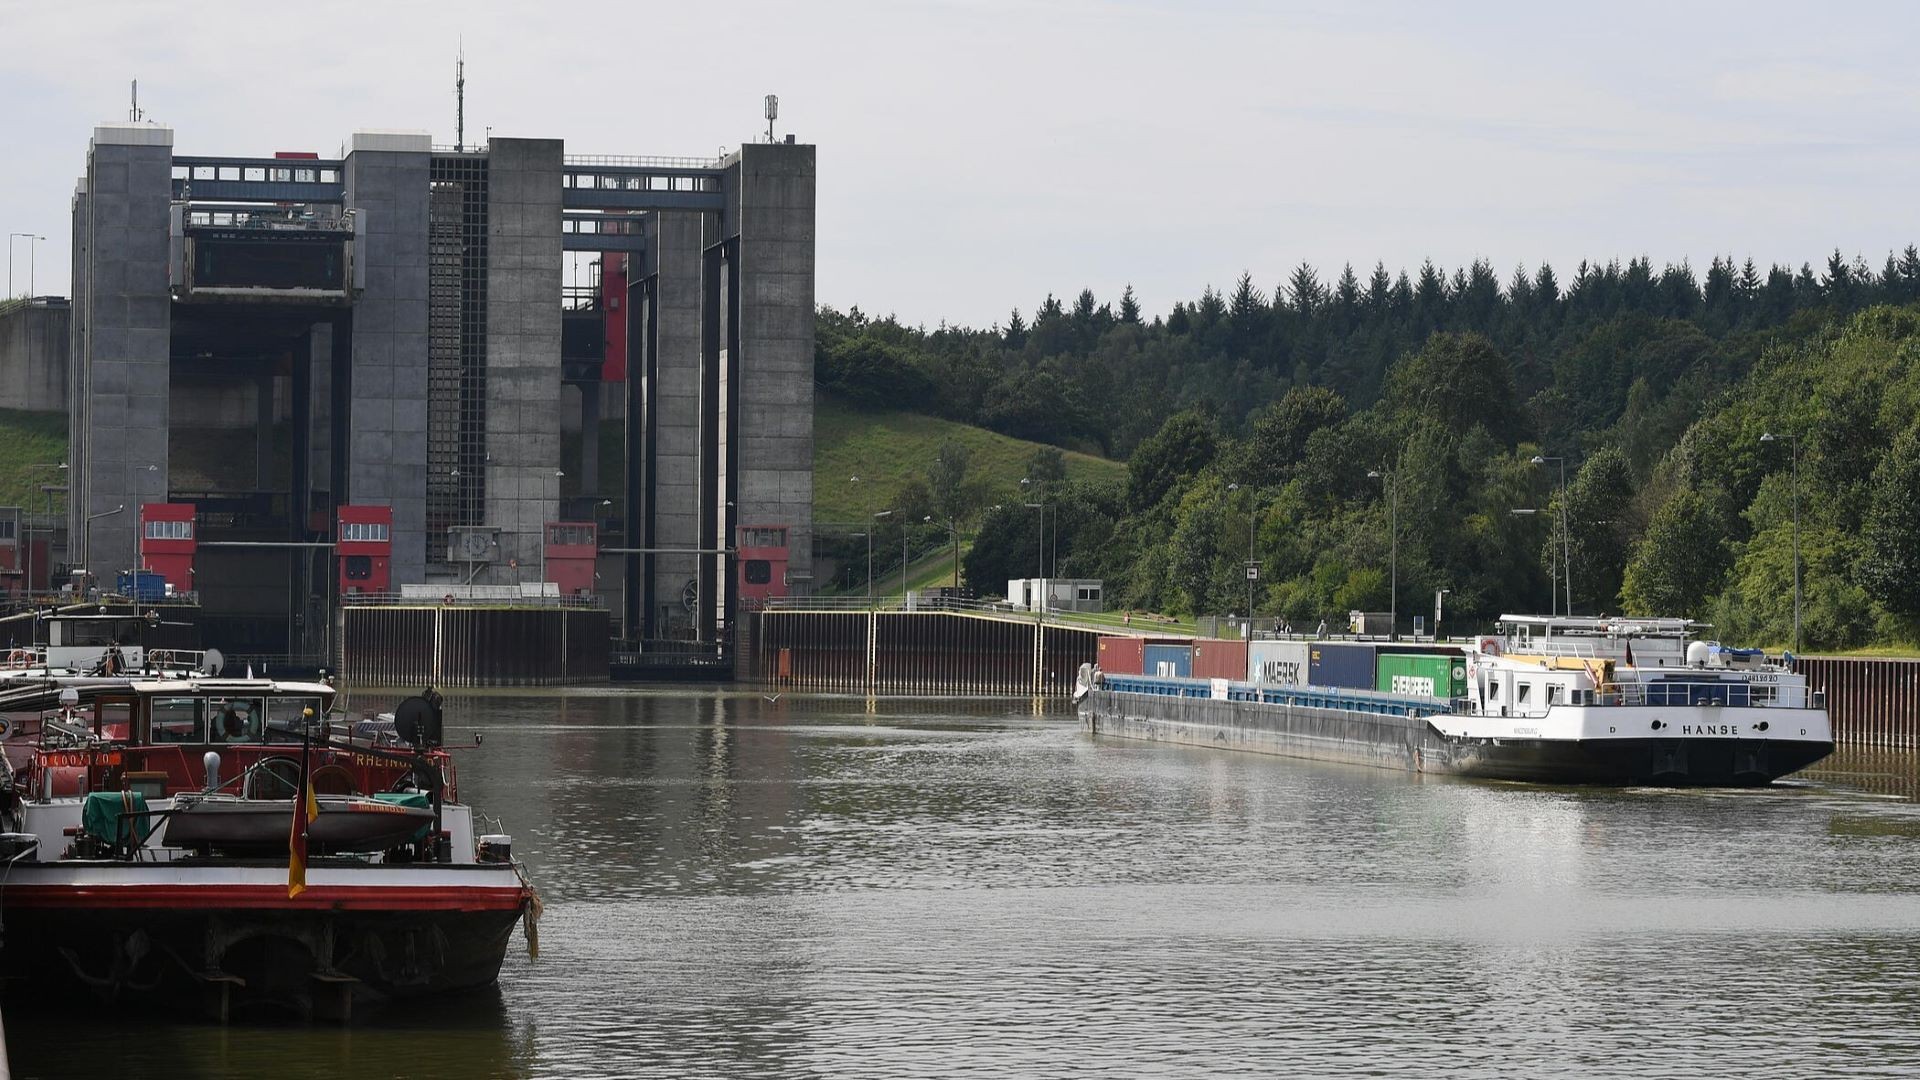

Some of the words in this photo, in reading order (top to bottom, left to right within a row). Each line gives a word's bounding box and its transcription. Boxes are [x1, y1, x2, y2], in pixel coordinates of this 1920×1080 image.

[1263, 661, 1300, 685] MAERSK
[1392, 675, 1434, 696] EVERGREEN
[1683, 725, 1738, 735] HANSE
